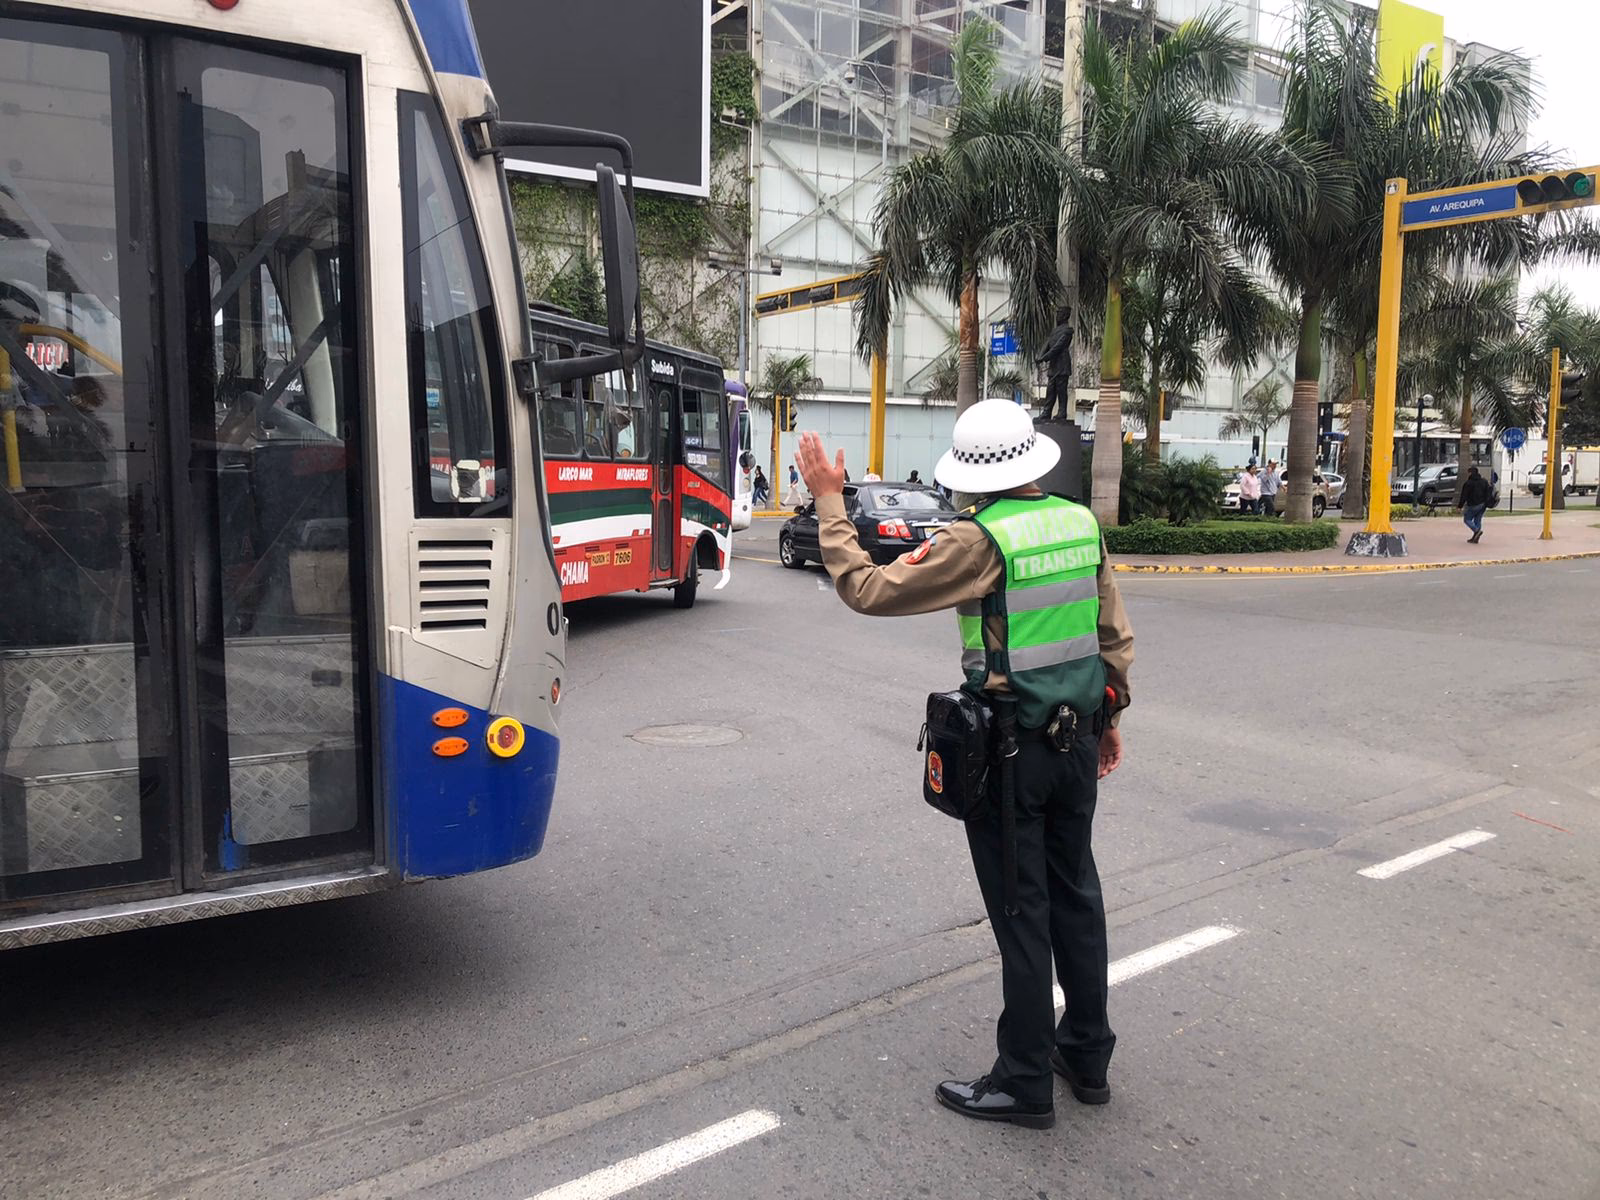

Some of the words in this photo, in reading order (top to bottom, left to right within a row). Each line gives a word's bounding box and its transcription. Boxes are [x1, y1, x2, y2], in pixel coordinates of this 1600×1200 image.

[1429, 204, 1442, 213] AV.
[1442, 198, 1485, 212] AREQUIPA
[650, 359, 675, 376] Subida
[558, 466, 579, 481] LARCO
[579, 467, 593, 482] MAR
[615, 467, 649, 481] MIRAFLORES
[1016, 545, 1099, 578] TRANSITO
[560, 561, 589, 586] CHAMA
